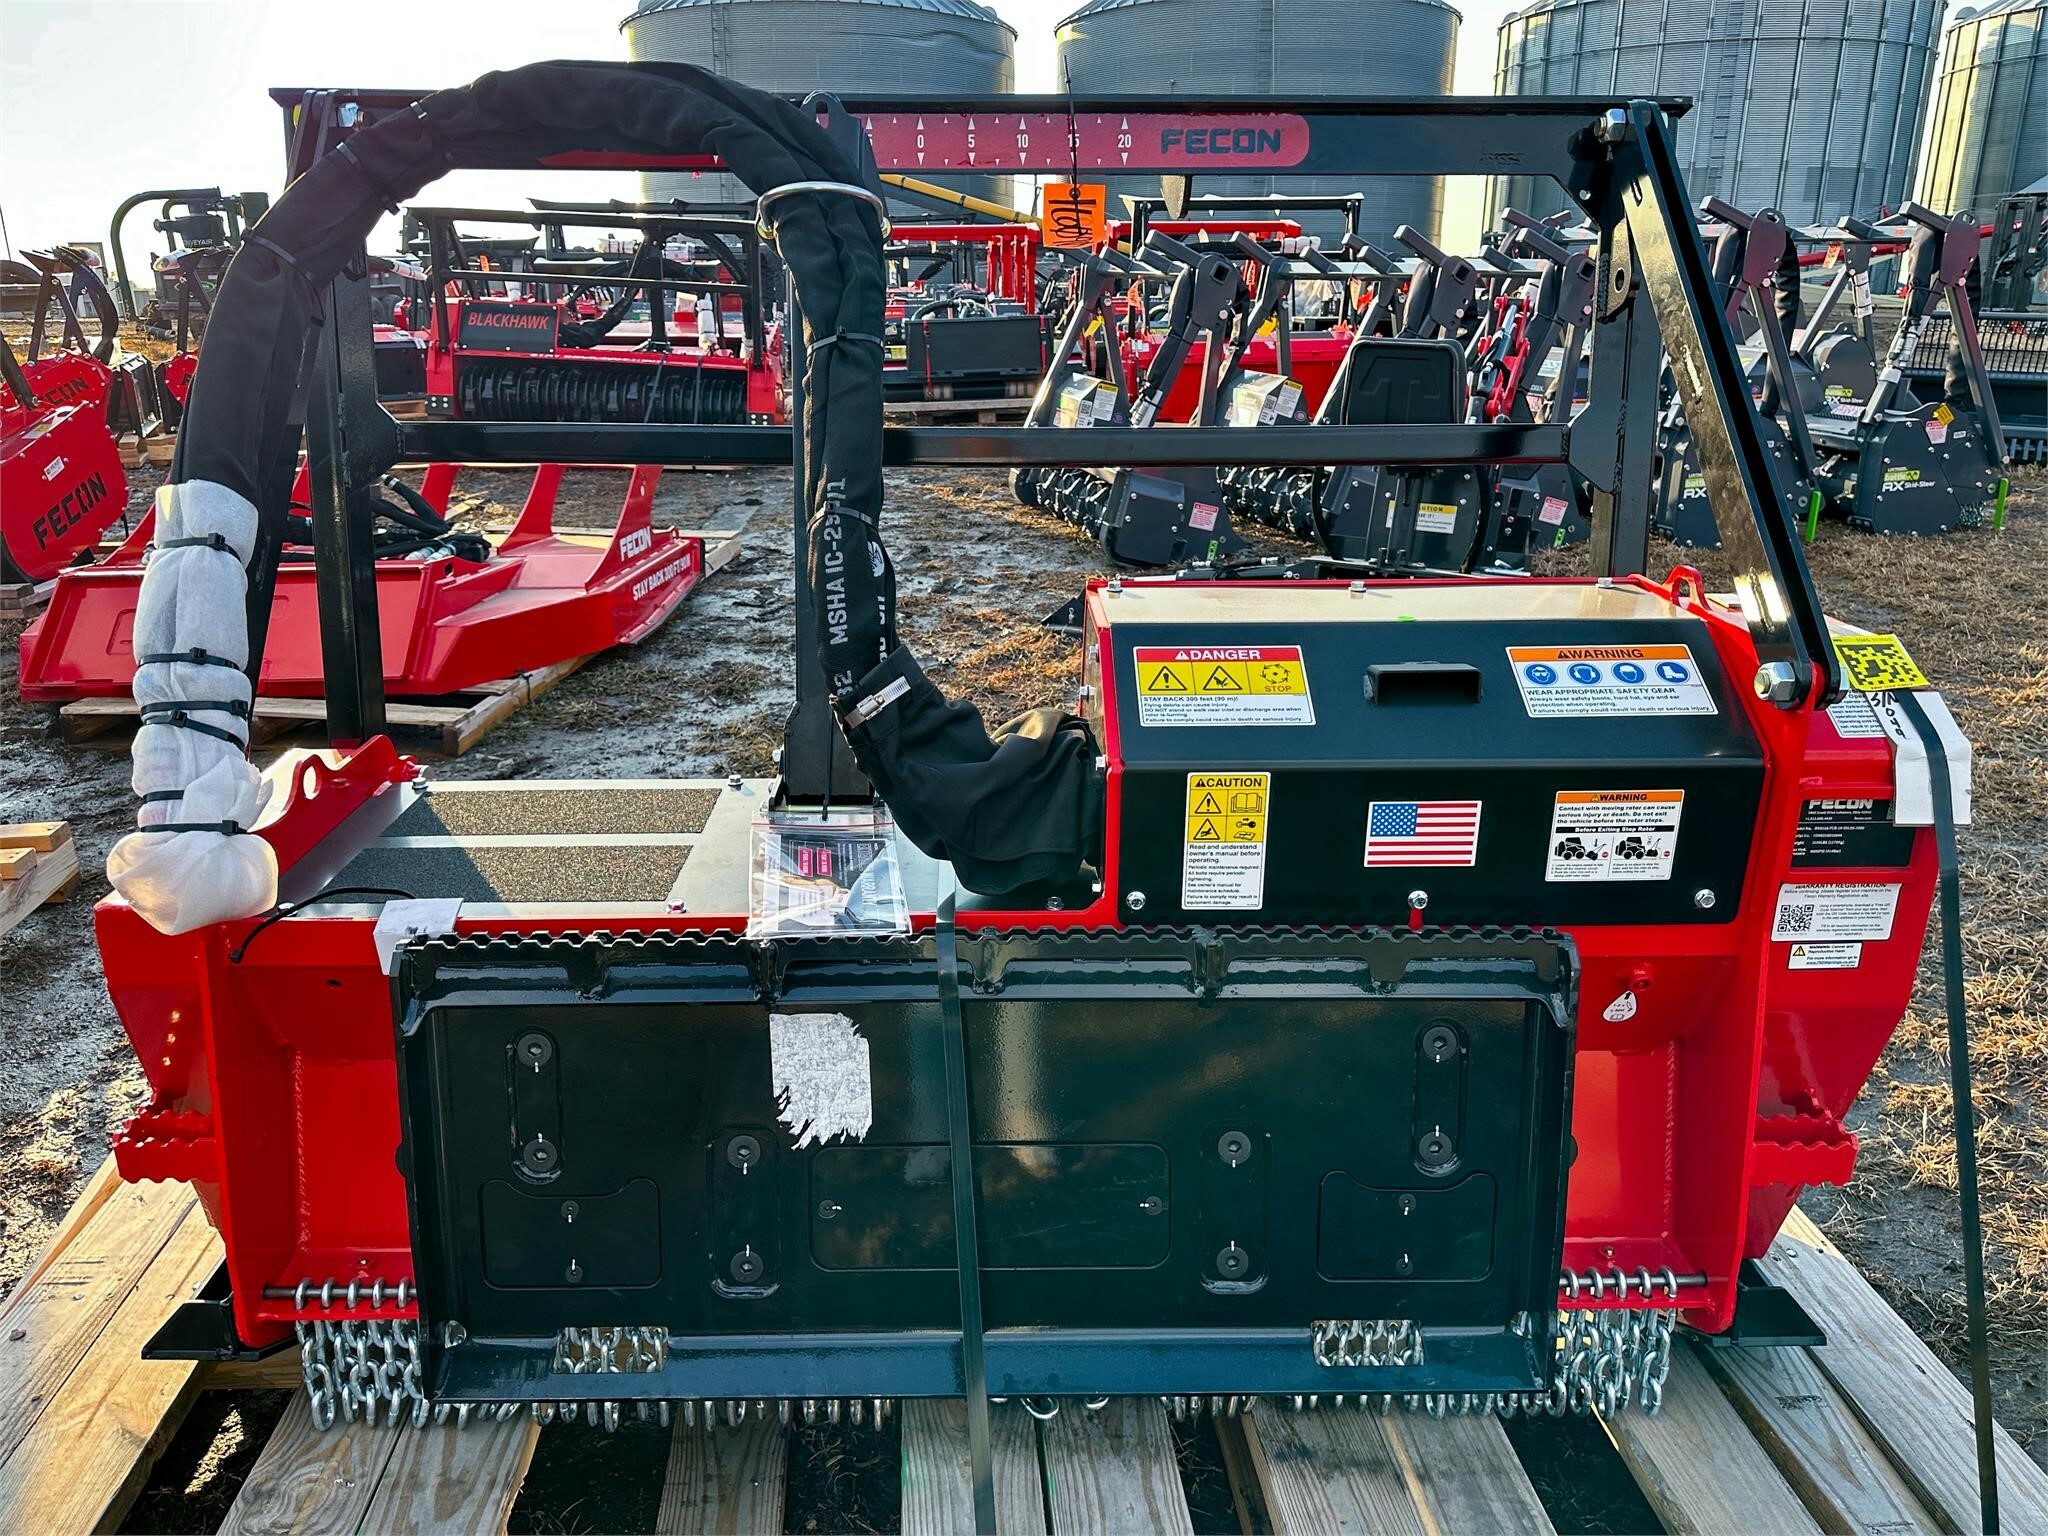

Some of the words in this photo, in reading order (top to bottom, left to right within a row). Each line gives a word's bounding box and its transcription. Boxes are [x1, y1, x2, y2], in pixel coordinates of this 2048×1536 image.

[917, 134, 924, 148] 0
[968, 134, 975, 148] 5
[1017, 134, 1029, 148] 10
[1068, 134, 1080, 148] 15
[1118, 134, 1132, 148] 20
[1161, 128, 1280, 154] FECON
[468, 312, 549, 329] BLACKHAWK
[44, 376, 90, 405] CON
[1684, 488, 1706, 498] AX
[1882, 481, 1904, 492] AX
[33, 472, 108, 551] FECON
[620, 526, 652, 562] FECON
[633, 579, 648, 601] STAY
[649, 569, 664, 591] BACK
[825, 577, 848, 645] MSHA
[1191, 650, 1260, 660] DANGER
[1567, 649, 1644, 659] WARNING
[1207, 778, 1262, 787] CAUTION
[1809, 799, 1873, 810] FECON
